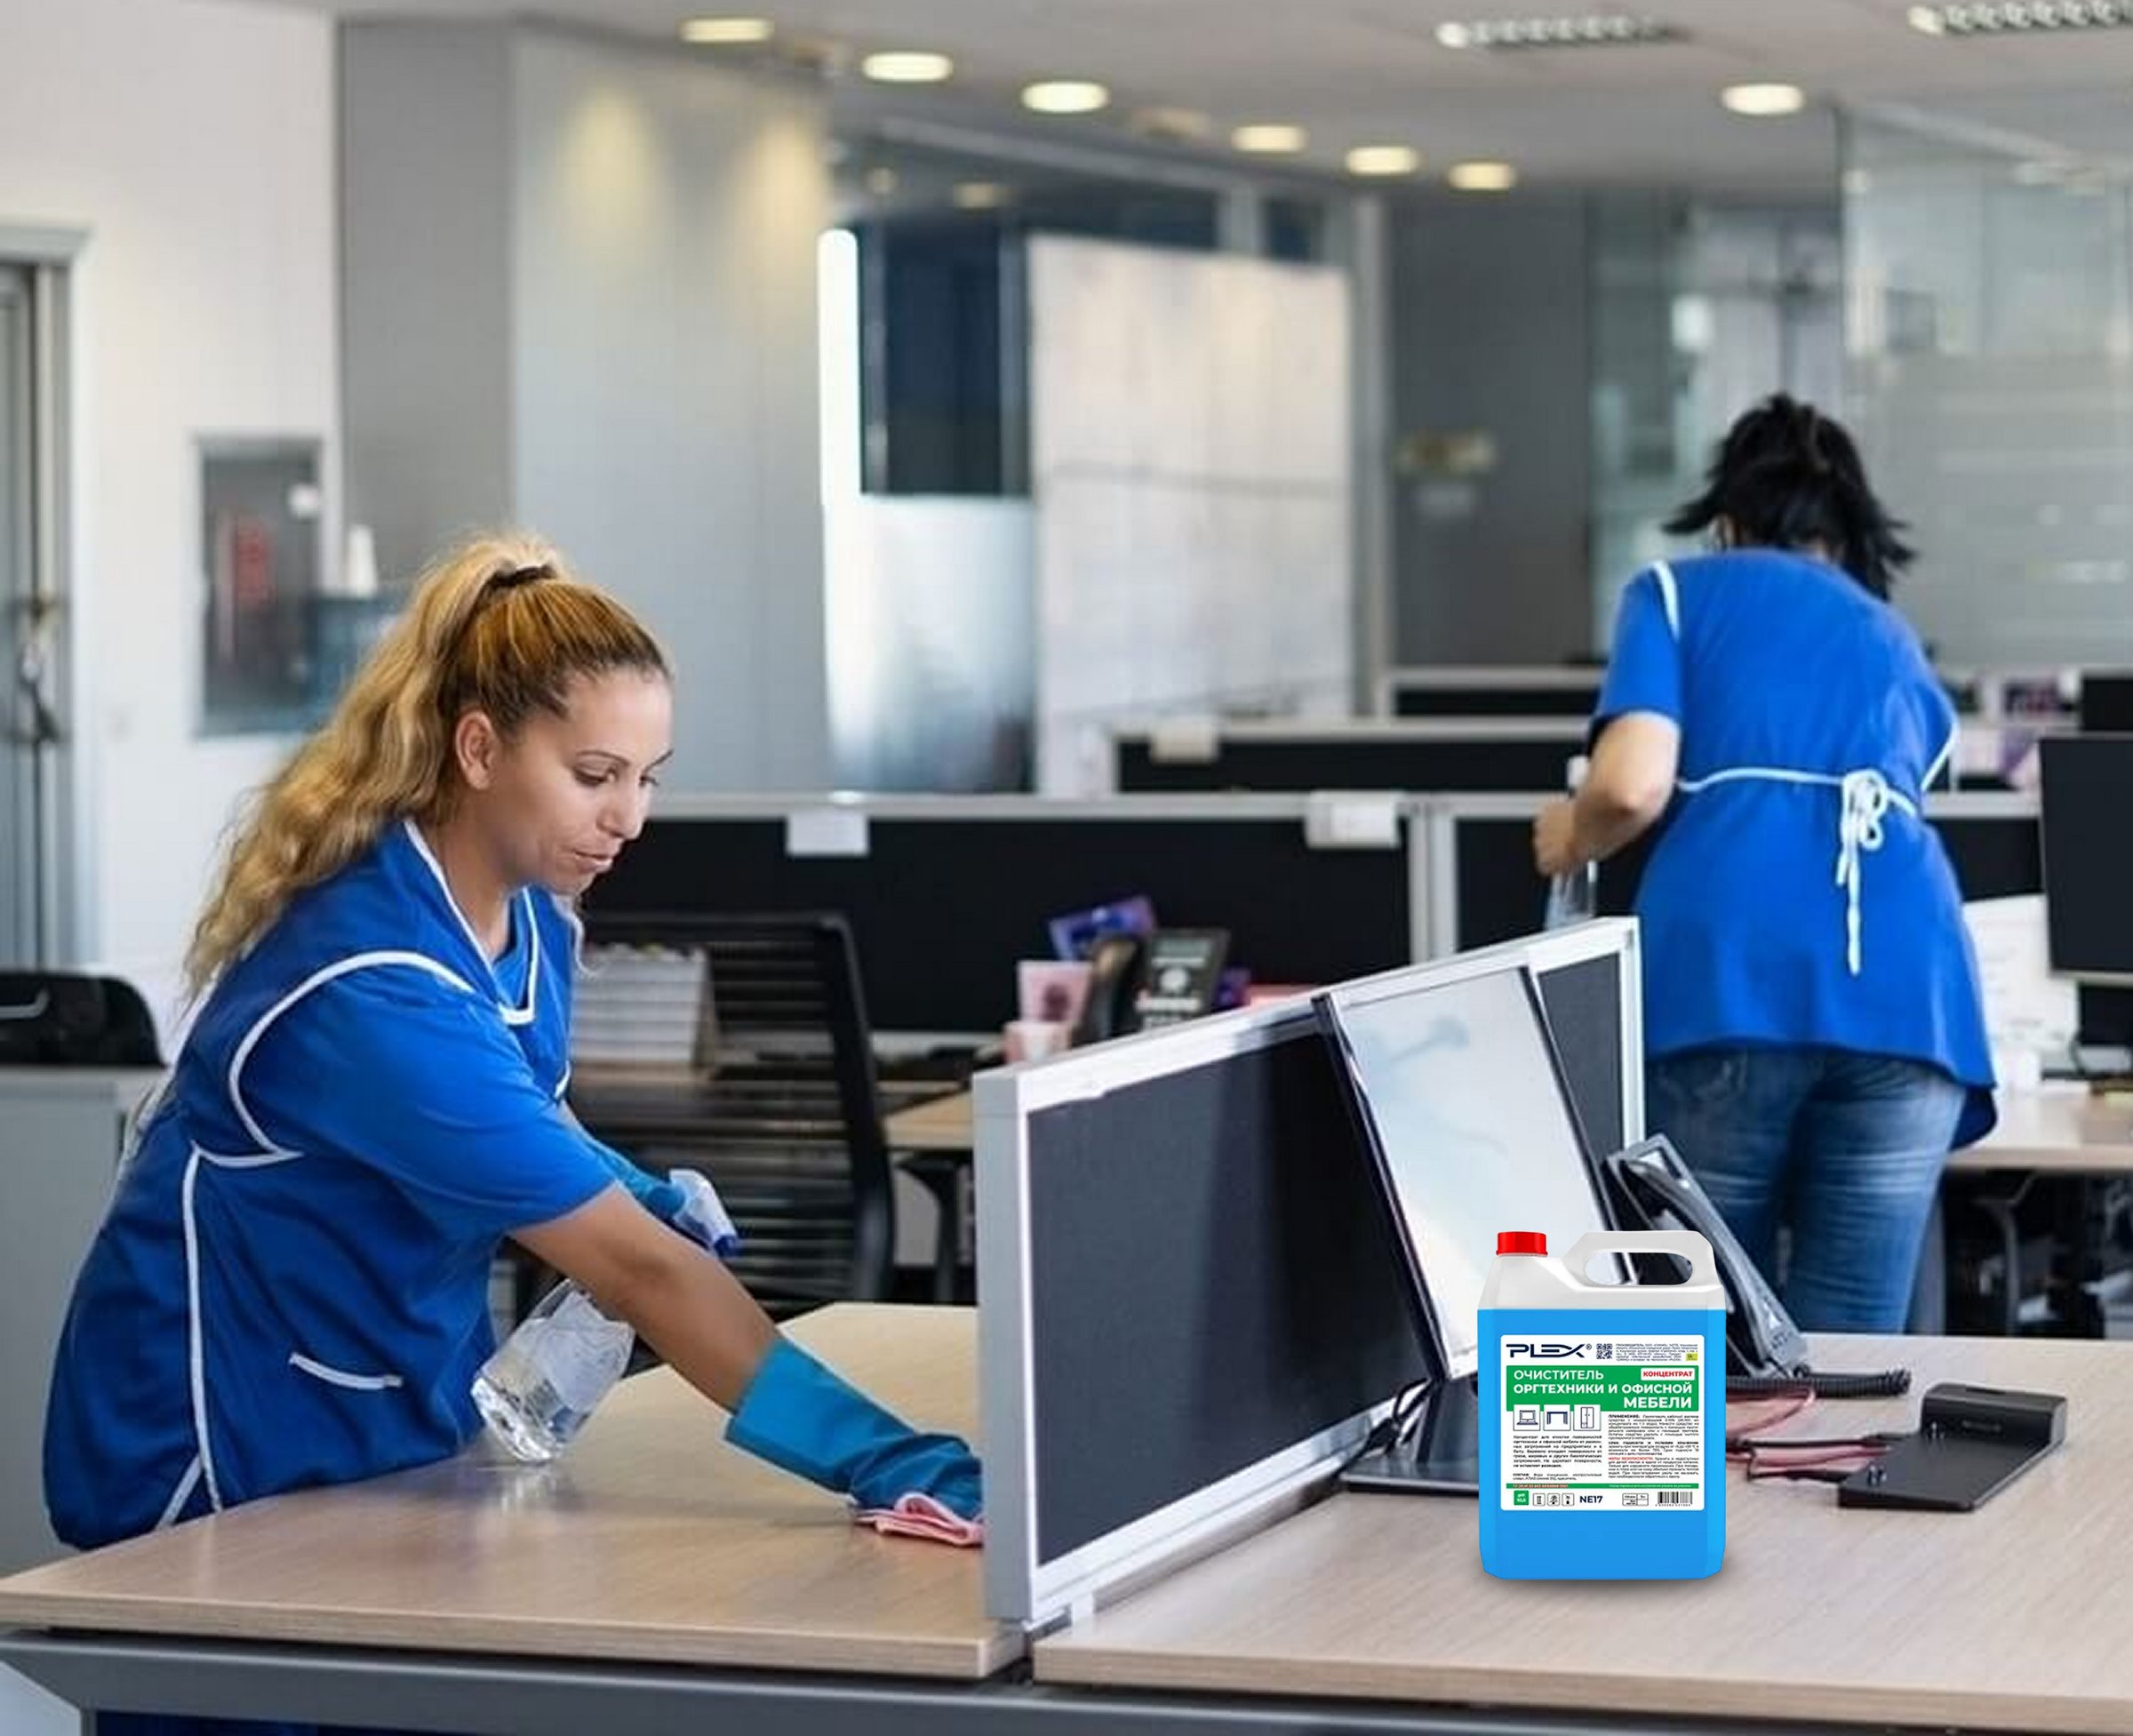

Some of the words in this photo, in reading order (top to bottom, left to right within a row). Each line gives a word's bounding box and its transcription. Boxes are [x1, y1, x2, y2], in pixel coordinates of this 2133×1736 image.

[1514, 1370, 1604, 1380] ОЧИСТИТЕЛЬ
[1514, 1384, 1604, 1394] ОРГТЕХНИКИ
[1608, 1384, 1618, 1394] И
[1621, 1381, 1692, 1394] ОФИСНОЙ
[1624, 1396, 1692, 1409] МЕБЕЛИ
[1579, 1495, 1603, 1503] NE17
